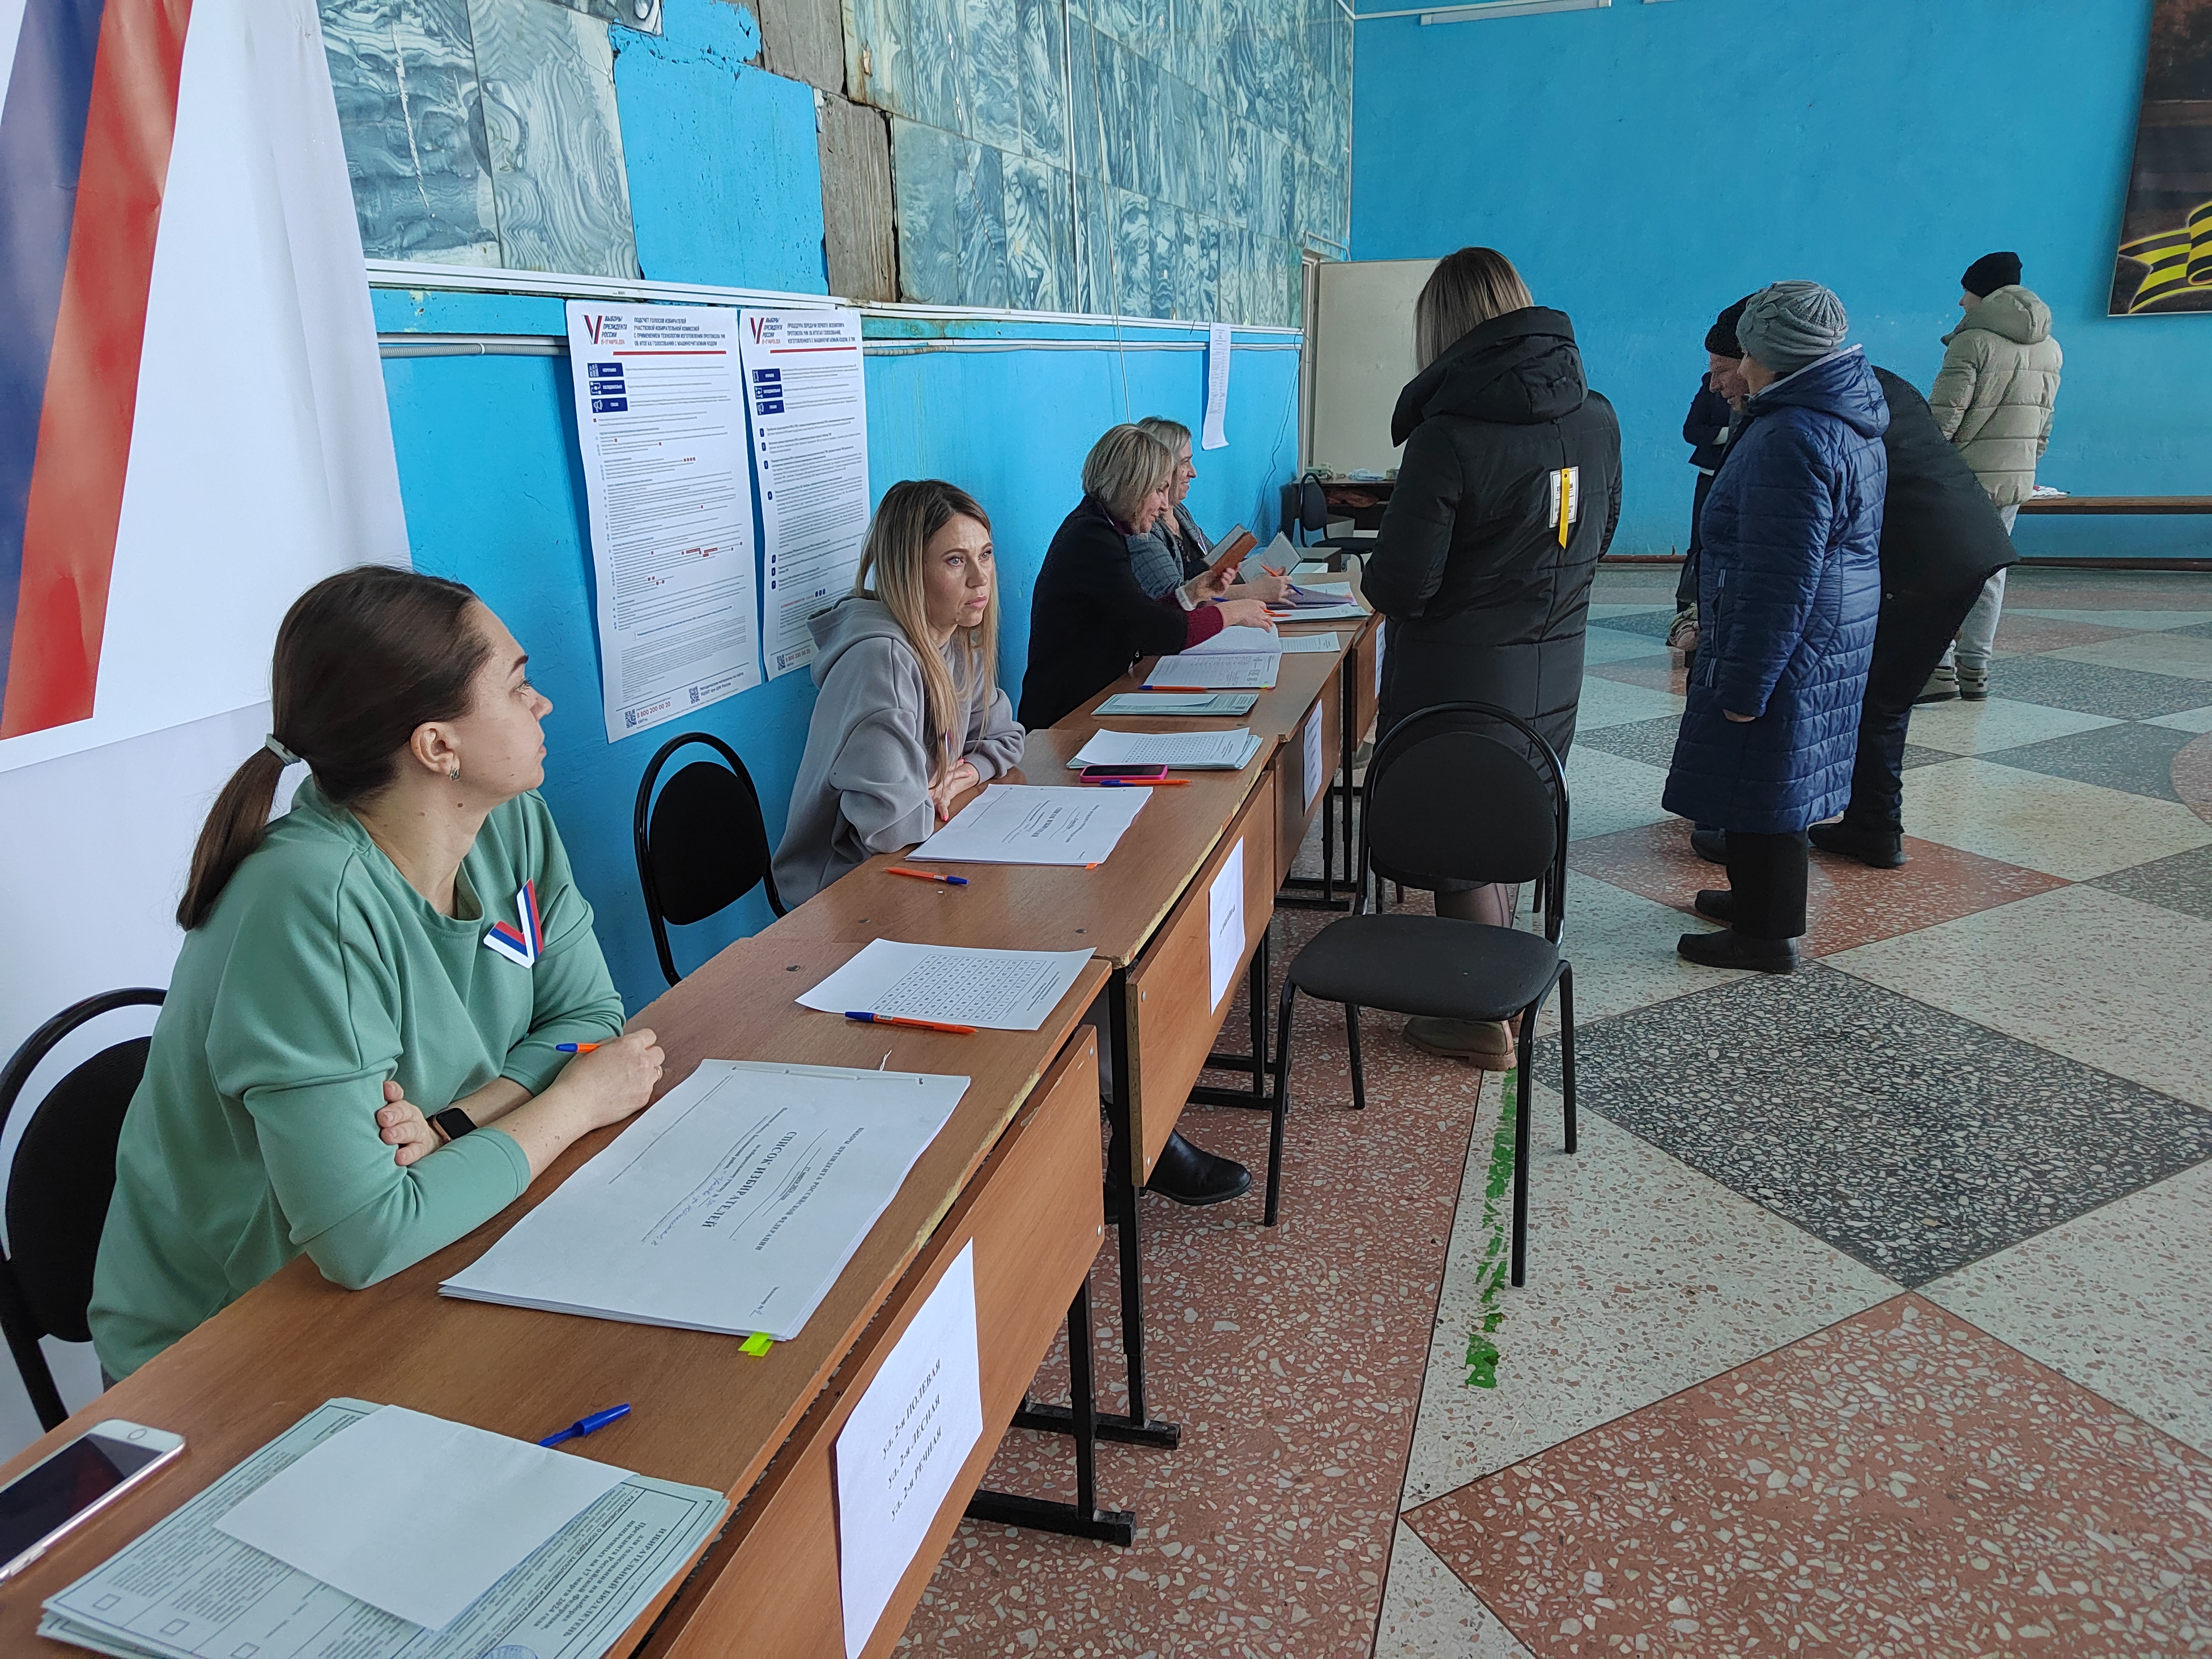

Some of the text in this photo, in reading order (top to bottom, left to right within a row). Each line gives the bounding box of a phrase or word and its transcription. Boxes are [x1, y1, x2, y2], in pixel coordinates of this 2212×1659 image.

[760, 1131, 798, 1165] СПИСОК
[700, 1167, 767, 1228] ИЗБИРАТЕЛЕЙ
[755, 1127, 865, 1250] ВЫБОРЫ ПРЕЗИДЕНТА РОССИЙСКОЙ ФЕДЕРАЦИИ
[883, 1358, 941, 1460] ул. 2-я ПОЛЕВАЯ
[888, 1392, 941, 1490] ул. 2-я ЛЕСНАЯ
[891, 1425, 942, 1522] ул. 2-я РЕЧНАЯ
[601, 1495, 635, 1528] РАЗЪЯСНЕНИЕ
[575, 1532, 598, 1556] ПОРЯДКЕ
[595, 1520, 636, 1559] назначенных
[612, 1521, 647, 1557] Президента
[634, 1534, 645, 1545] для
[543, 1555, 577, 1591] ЗАПОЛНЕНИЯ
[581, 1567, 591, 1577] 17
[582, 1555, 616, 1590] Российской
[588, 1558, 599, 1568] на
[595, 1543, 636, 1585] голосования
[609, 1527, 667, 1590] ИЗБИРАТЕЛЬНЫЙ
[568, 1576, 584, 1592] марта
[588, 1584, 598, 1594] на
[548, 1597, 567, 1614] 2024
[563, 1588, 611, 1637] БЮЛЛЕТЕНЬ
